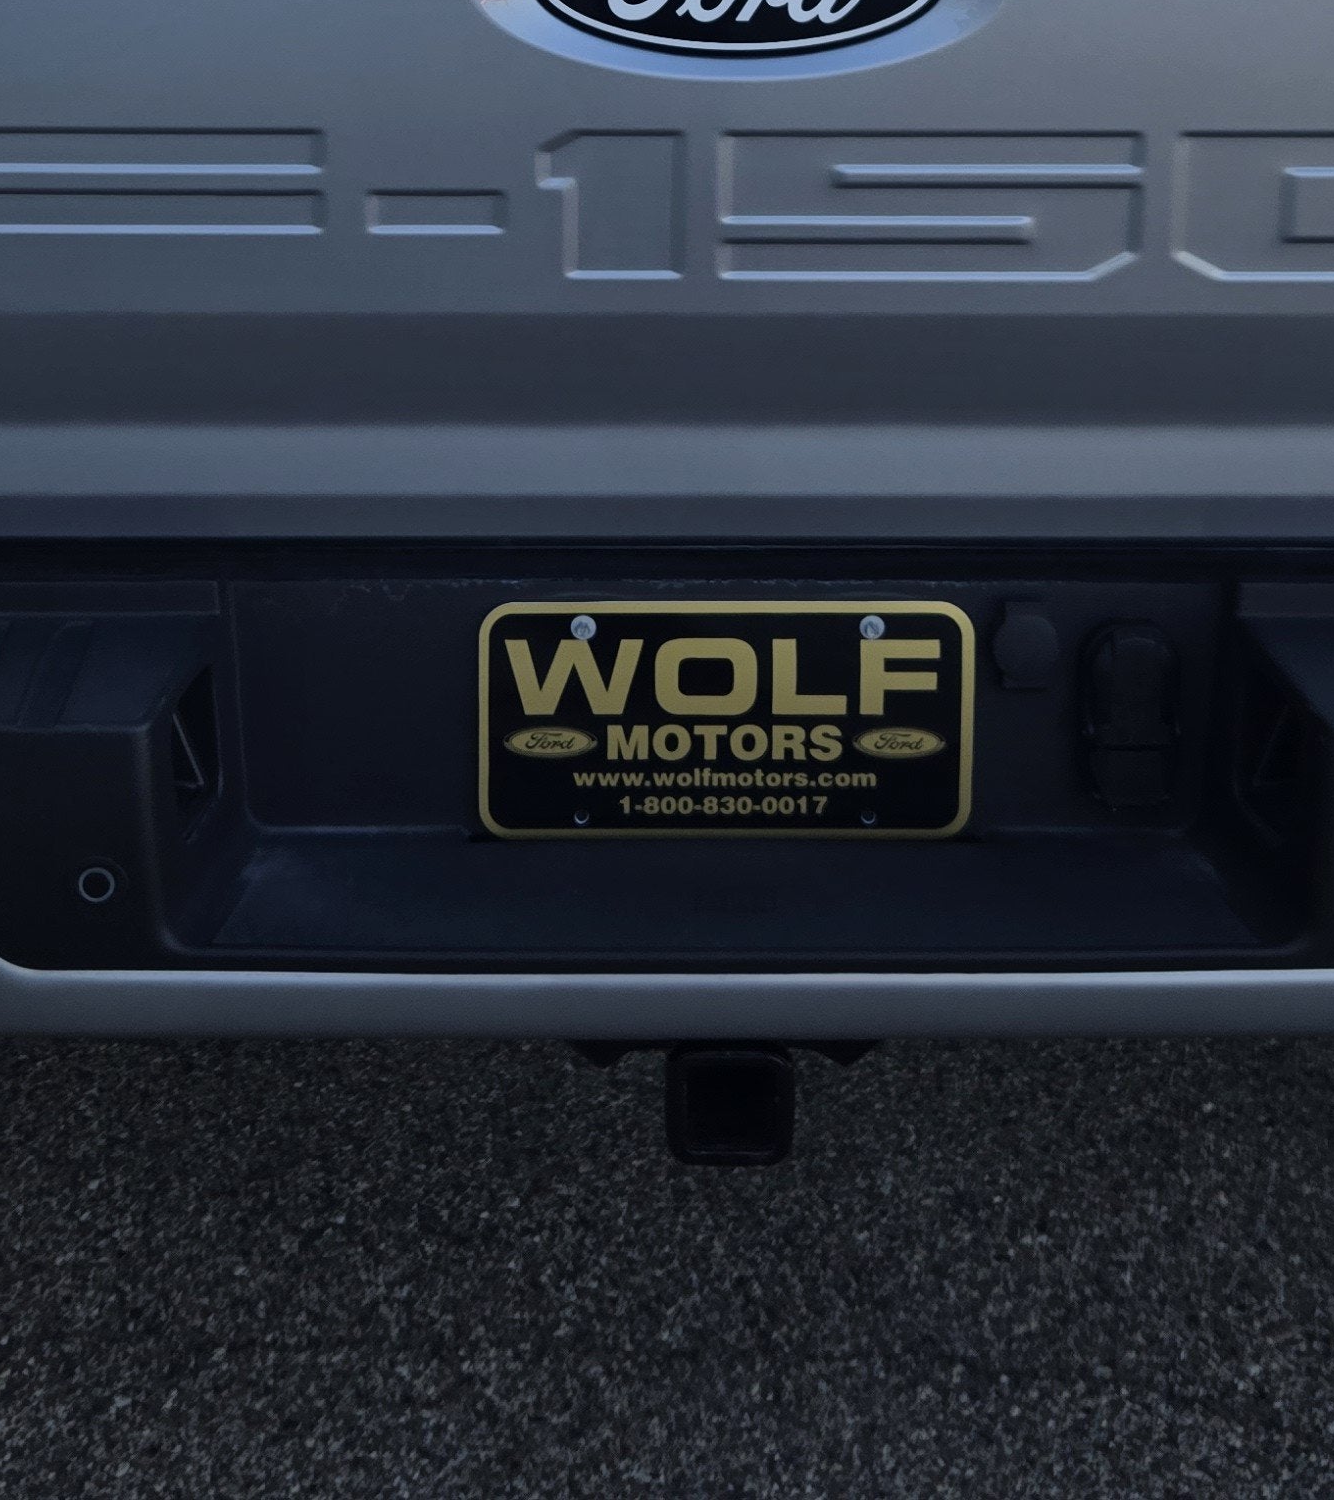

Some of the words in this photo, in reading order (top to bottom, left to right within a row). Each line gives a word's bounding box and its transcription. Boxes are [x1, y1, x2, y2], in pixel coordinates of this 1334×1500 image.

[505, 637, 942, 716] WOLF
[523, 730, 574, 752] Ford
[606, 723, 844, 762] MOTORS
[872, 730, 924, 752] Ford
[572, 767, 878, 788] www.wolfmotors.com
[619, 796, 828, 816] 1-800-830-0017
